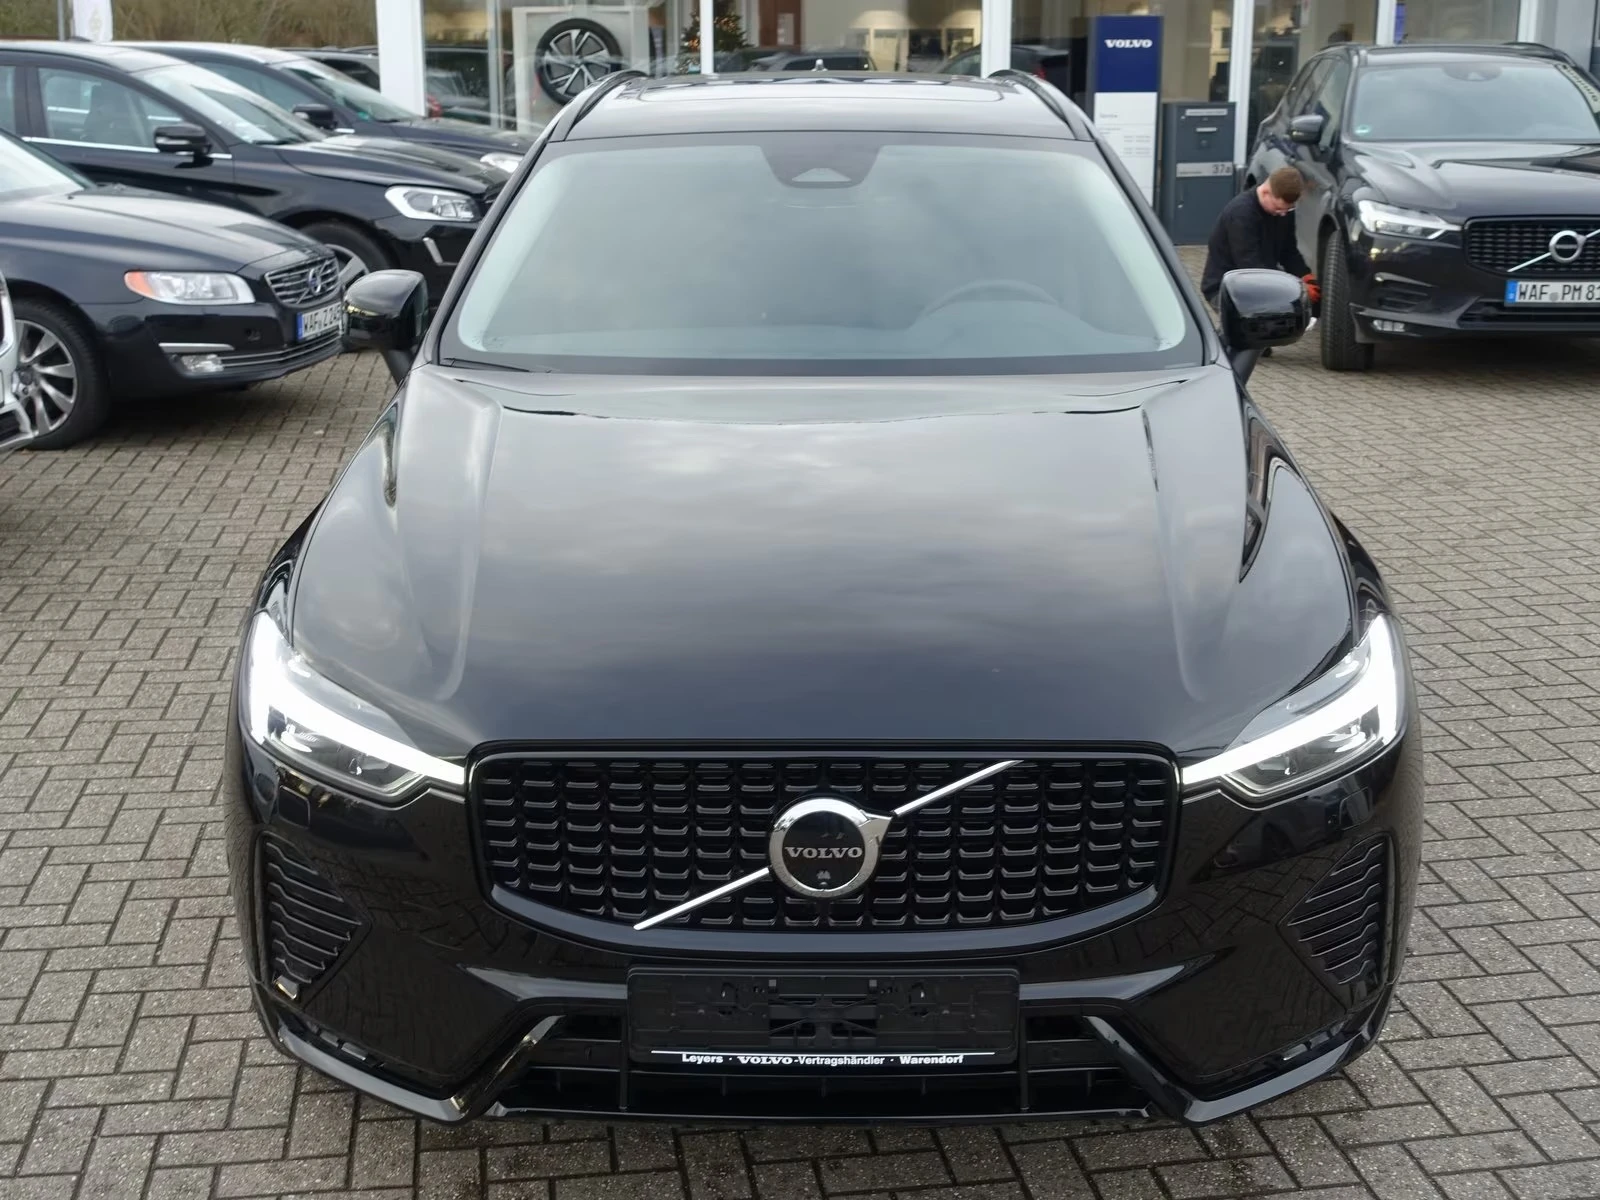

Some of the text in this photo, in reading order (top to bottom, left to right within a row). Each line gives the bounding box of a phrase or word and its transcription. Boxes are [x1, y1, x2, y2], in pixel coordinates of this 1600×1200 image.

[1104, 39, 1153, 48] VOLVO
[1518, 284, 1550, 300] WAF
[1561, 284, 1583, 300] PM
[784, 847, 863, 858] VOLVO
[682, 1053, 723, 1064] Leyers
[899, 1054, 964, 1064] Warendorf
